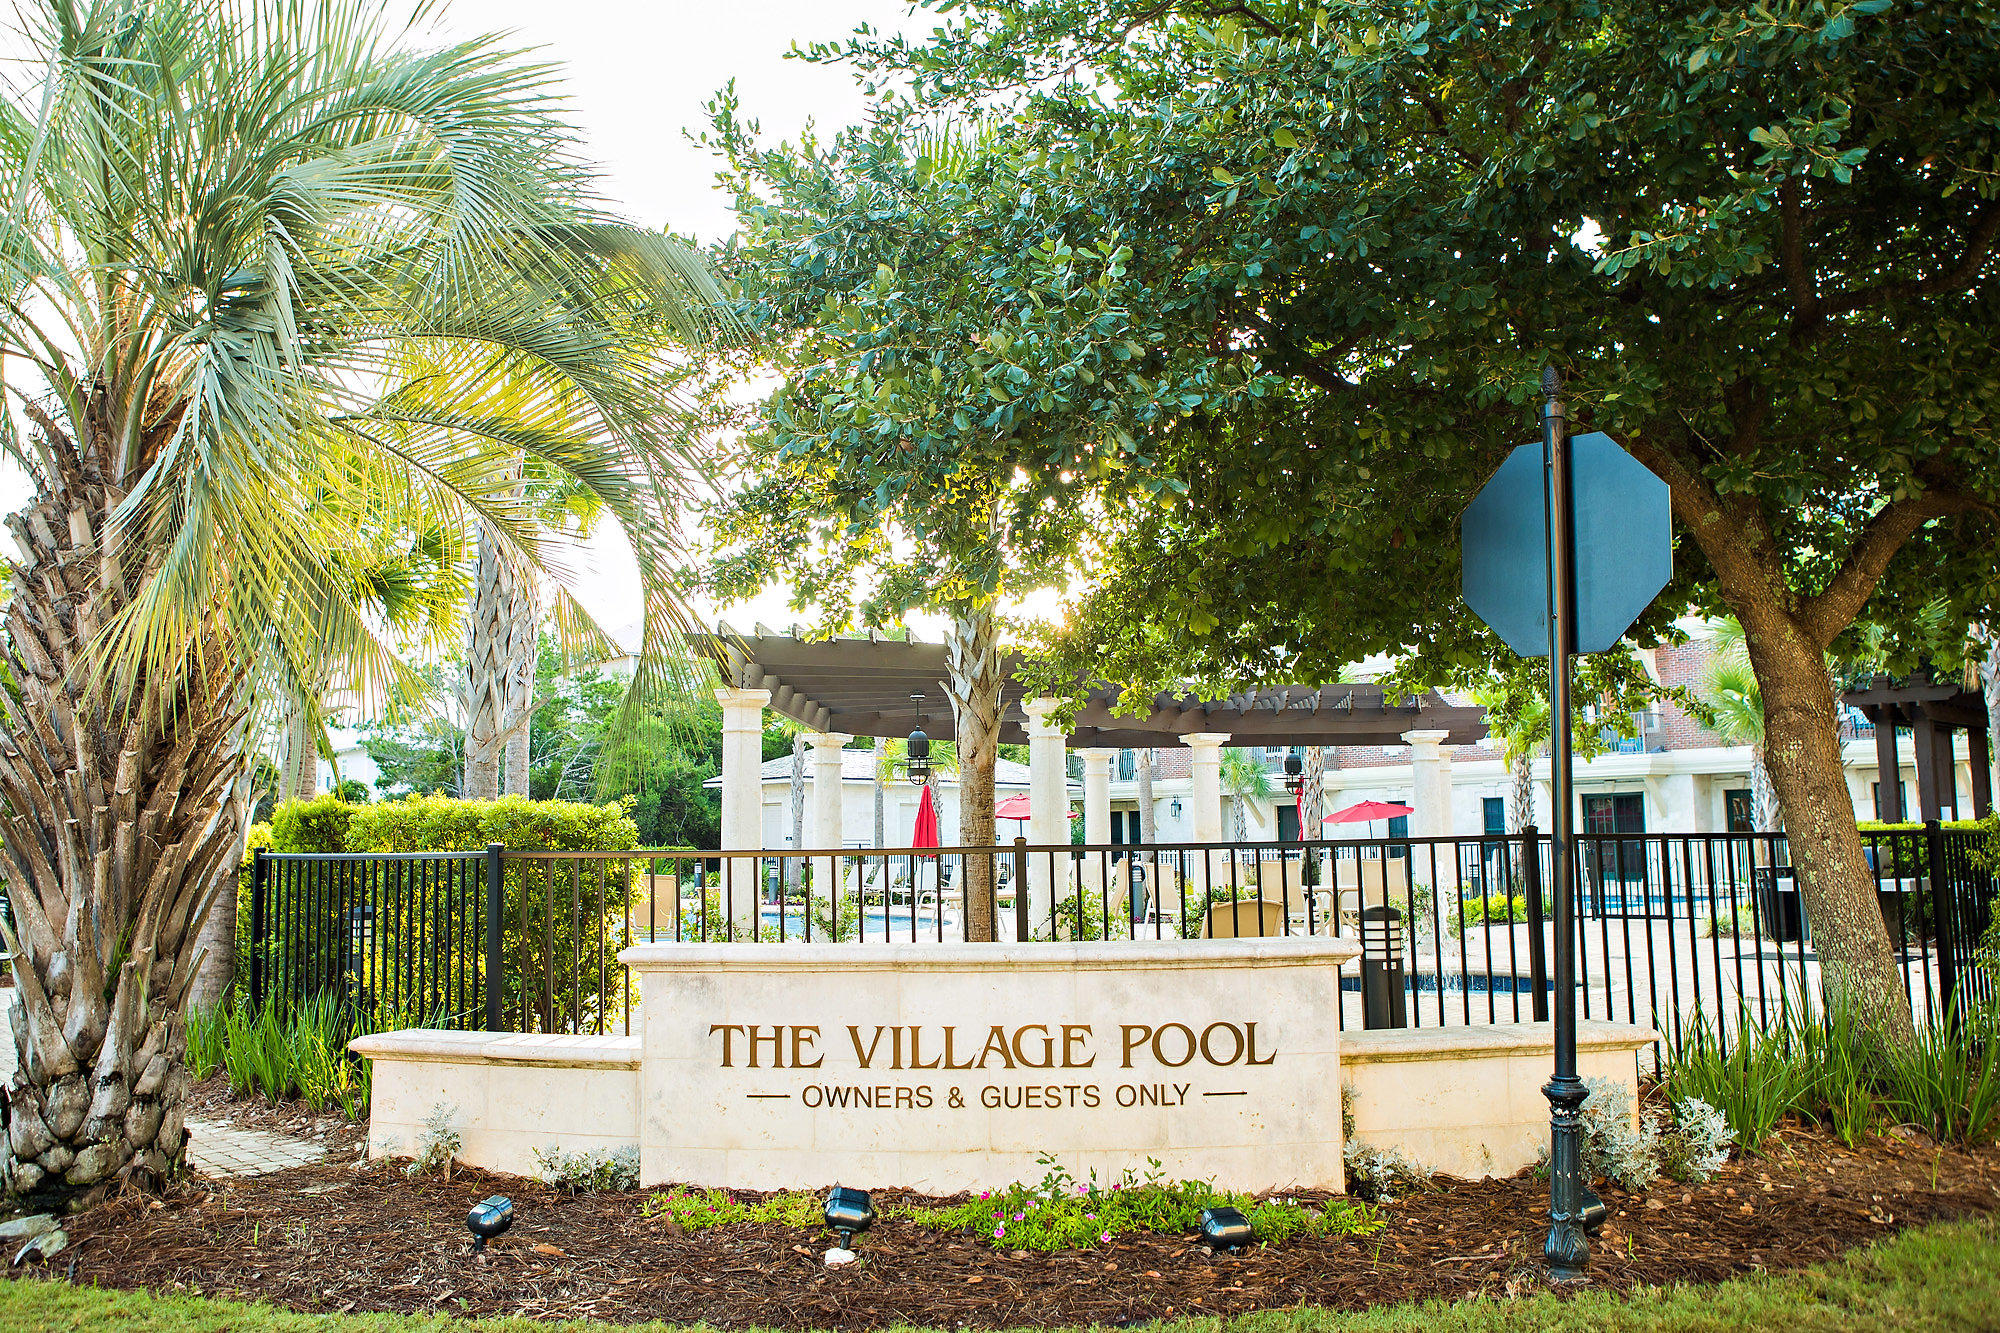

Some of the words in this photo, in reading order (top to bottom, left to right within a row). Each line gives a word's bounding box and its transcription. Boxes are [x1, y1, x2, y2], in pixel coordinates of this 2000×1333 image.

[709, 1025, 824, 1068] THE
[846, 1025, 1096, 1069] VILLAGE
[1119, 1022, 1277, 1068] POOL
[802, 1085, 933, 1109] OWNERS
[948, 1087, 965, 1108] &
[981, 1085, 1100, 1109] GUESTS
[1116, 1083, 1191, 1107] ONLY
